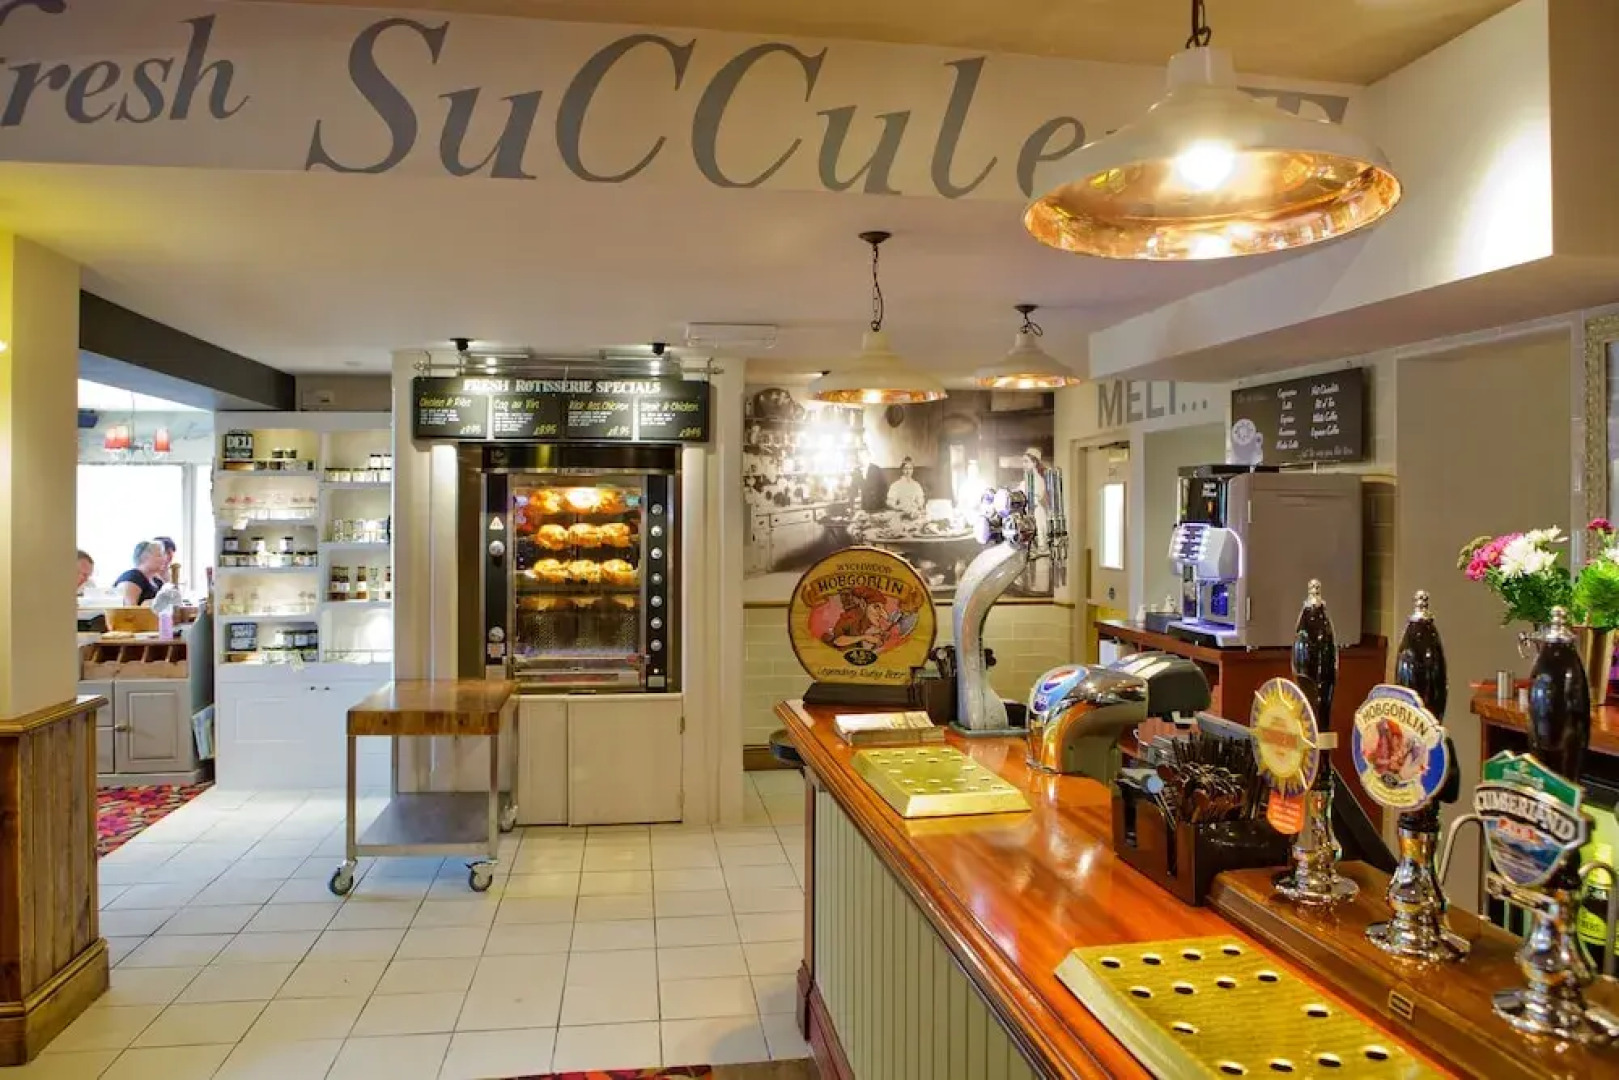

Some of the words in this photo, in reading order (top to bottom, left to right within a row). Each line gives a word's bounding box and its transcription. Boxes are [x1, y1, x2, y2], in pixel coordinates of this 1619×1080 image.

[305, 18, 1349, 198] SuCCule
[463, 379, 509, 392] FRESH
[515, 379, 593, 393] ROTISSERIE
[596, 380, 661, 394] SPECIALS
[818, 575, 904, 594] HOBGOBLIN
[1362, 701, 1428, 738] HOBGOBLIN
[1476, 789, 1575, 840] CUMBERLAND
